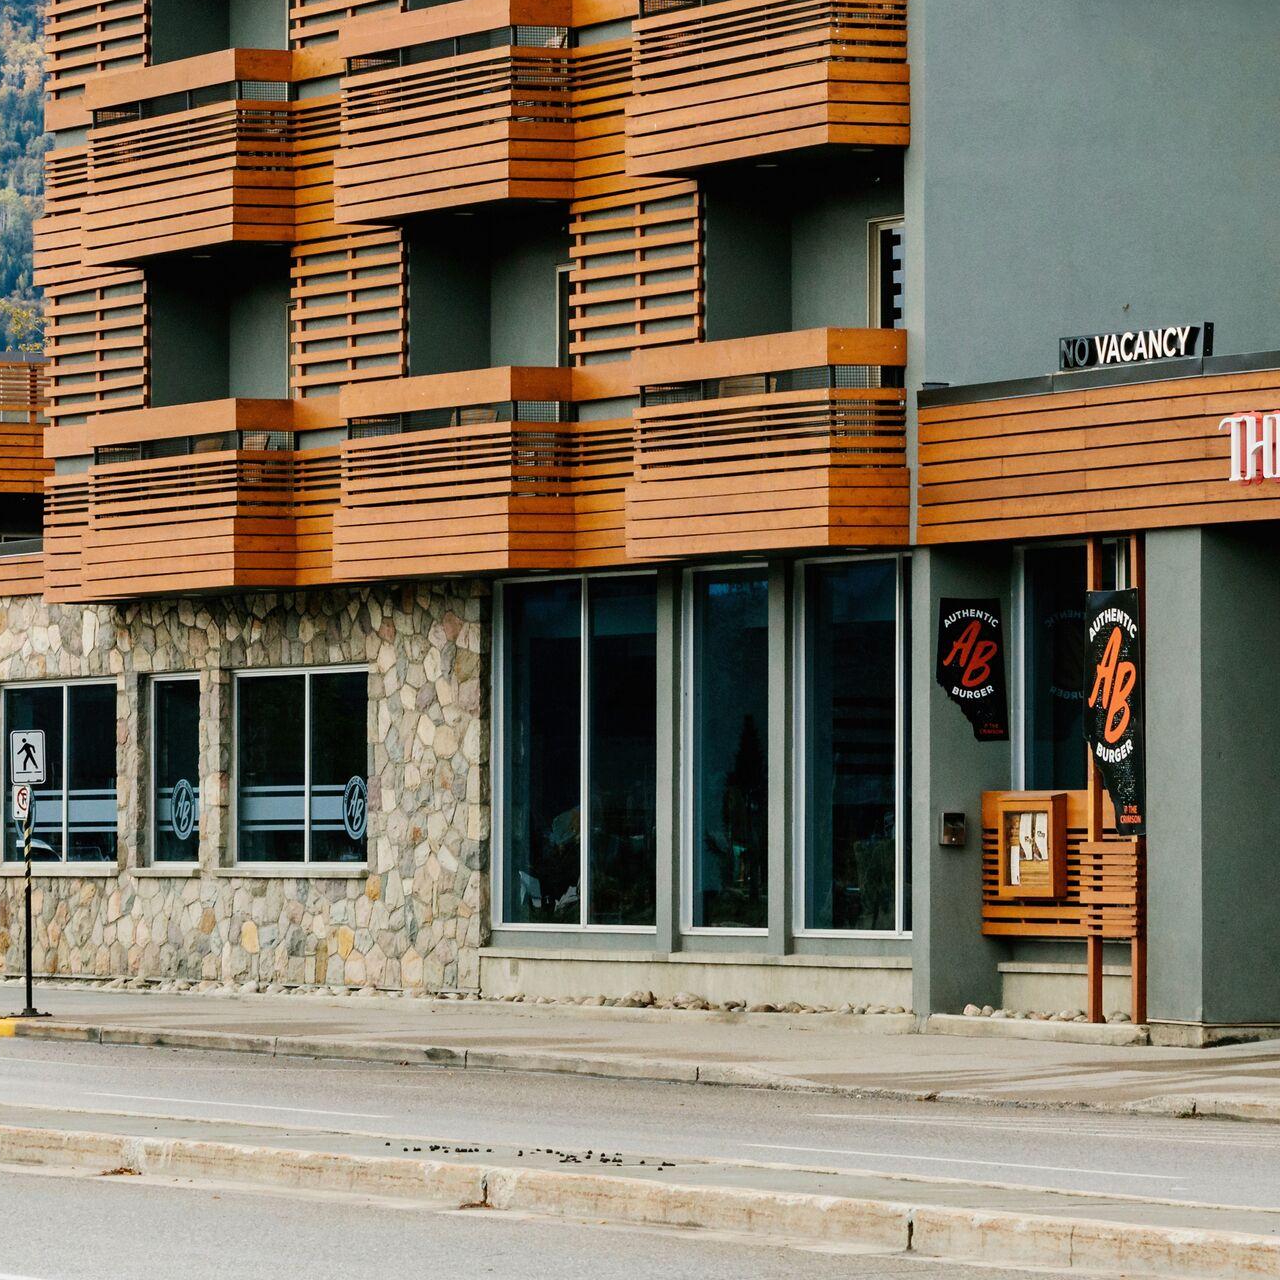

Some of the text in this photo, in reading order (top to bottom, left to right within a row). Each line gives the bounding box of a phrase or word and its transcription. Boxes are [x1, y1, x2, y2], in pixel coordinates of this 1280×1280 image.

[1061, 325, 1191, 368] NO VACANCY
[943, 608, 999, 629] AUTHENTIC
[1088, 607, 1138, 643] AUTHENTIC
[943, 619, 998, 688] AB
[951, 685, 995, 700] BURGER
[1088, 626, 1137, 744] AB
[1096, 738, 1134, 764] BURGER
[175, 788, 191, 832] AB
[347, 784, 364, 831] AB
